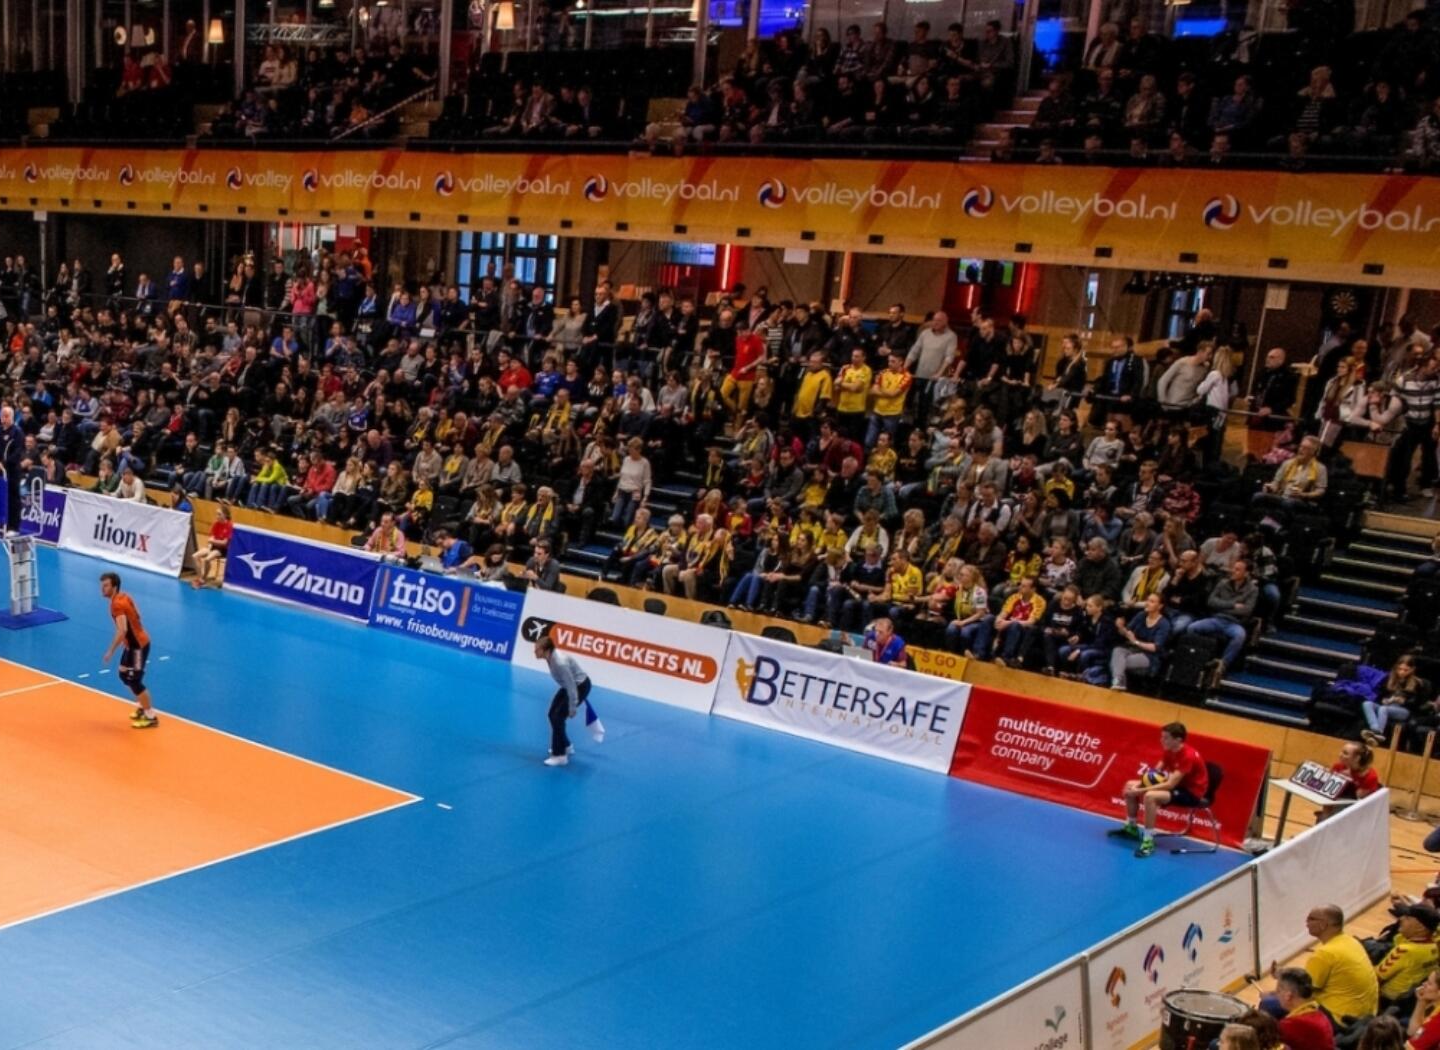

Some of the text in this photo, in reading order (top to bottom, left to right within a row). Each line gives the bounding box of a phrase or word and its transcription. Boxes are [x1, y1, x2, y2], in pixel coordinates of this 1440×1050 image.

[40, 164, 110, 184] volleybal.nl
[137, 166, 216, 188] volleybal.nl
[246, 168, 294, 192] volley
[322, 165, 420, 190] volleybal.nl
[460, 172, 570, 198] volleybal.nl
[612, 178, 739, 205] volleybal.nl
[792, 182, 941, 212] volleybal.nl
[1000, 189, 1177, 223] volleybal.nl
[1248, 201, 1440, 236] volleybal.n
[93, 513, 151, 553] ilionx
[390, 573, 456, 616] friso
[375, 613, 509, 655] www. frisobouwgroep.nl
[934, 654, 957, 669] GO
[749, 655, 951, 735] BETTERSAFE
[777, 697, 944, 746] INTERNATIONAL
[998, 715, 1102, 749] multicopy the
[990, 743, 1054, 770] company
[994, 729, 1103, 765] communication
